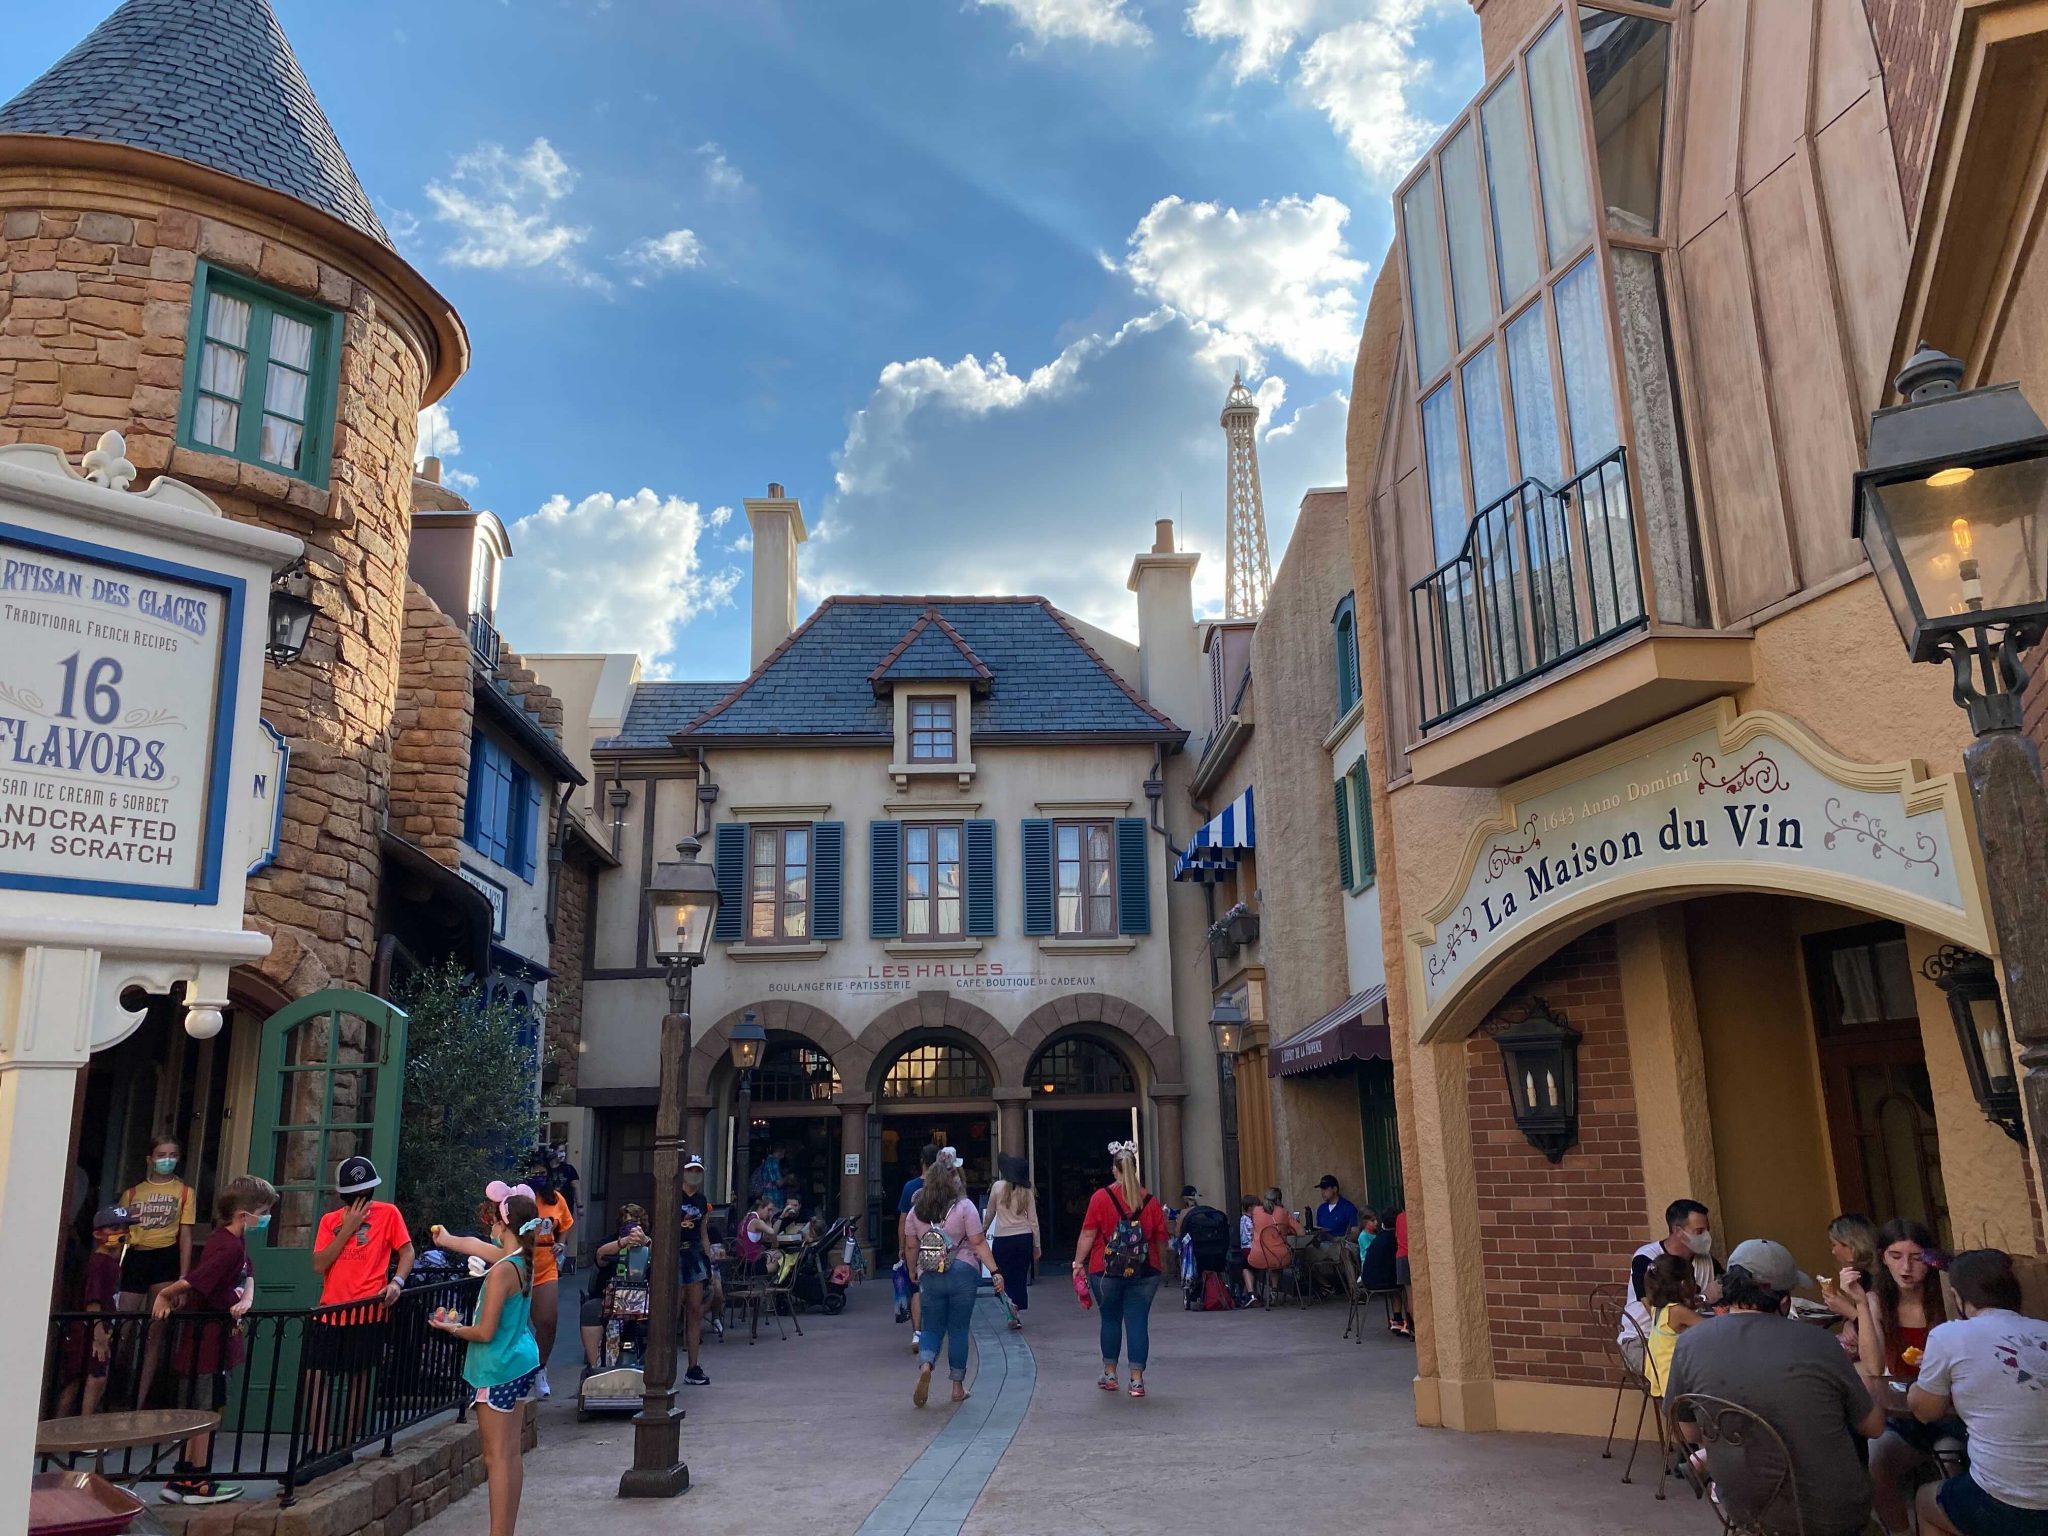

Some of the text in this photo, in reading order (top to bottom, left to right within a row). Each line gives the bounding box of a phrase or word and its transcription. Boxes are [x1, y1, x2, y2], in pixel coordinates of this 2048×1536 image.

[0, 558, 207, 637] RTISAN DES GLACES
[5, 603, 178, 652] TRADITIONAL FRENCH RECIPES
[55, 650, 124, 725] 16
[33, 782, 55, 800] ICE
[59, 785, 104, 806] CREAM
[109, 792, 117, 808] &
[123, 793, 169, 814] SORBET
[1542, 763, 1690, 833] 1643 Anno Domini
[0, 803, 177, 842] NDCRAFTED
[50, 835, 173, 866] SCRATCH
[1480, 803, 1803, 933] La Maison du Vin
[867, 963, 1004, 979] LES HALLES
[1050, 976, 1096, 986] CADEAUX
